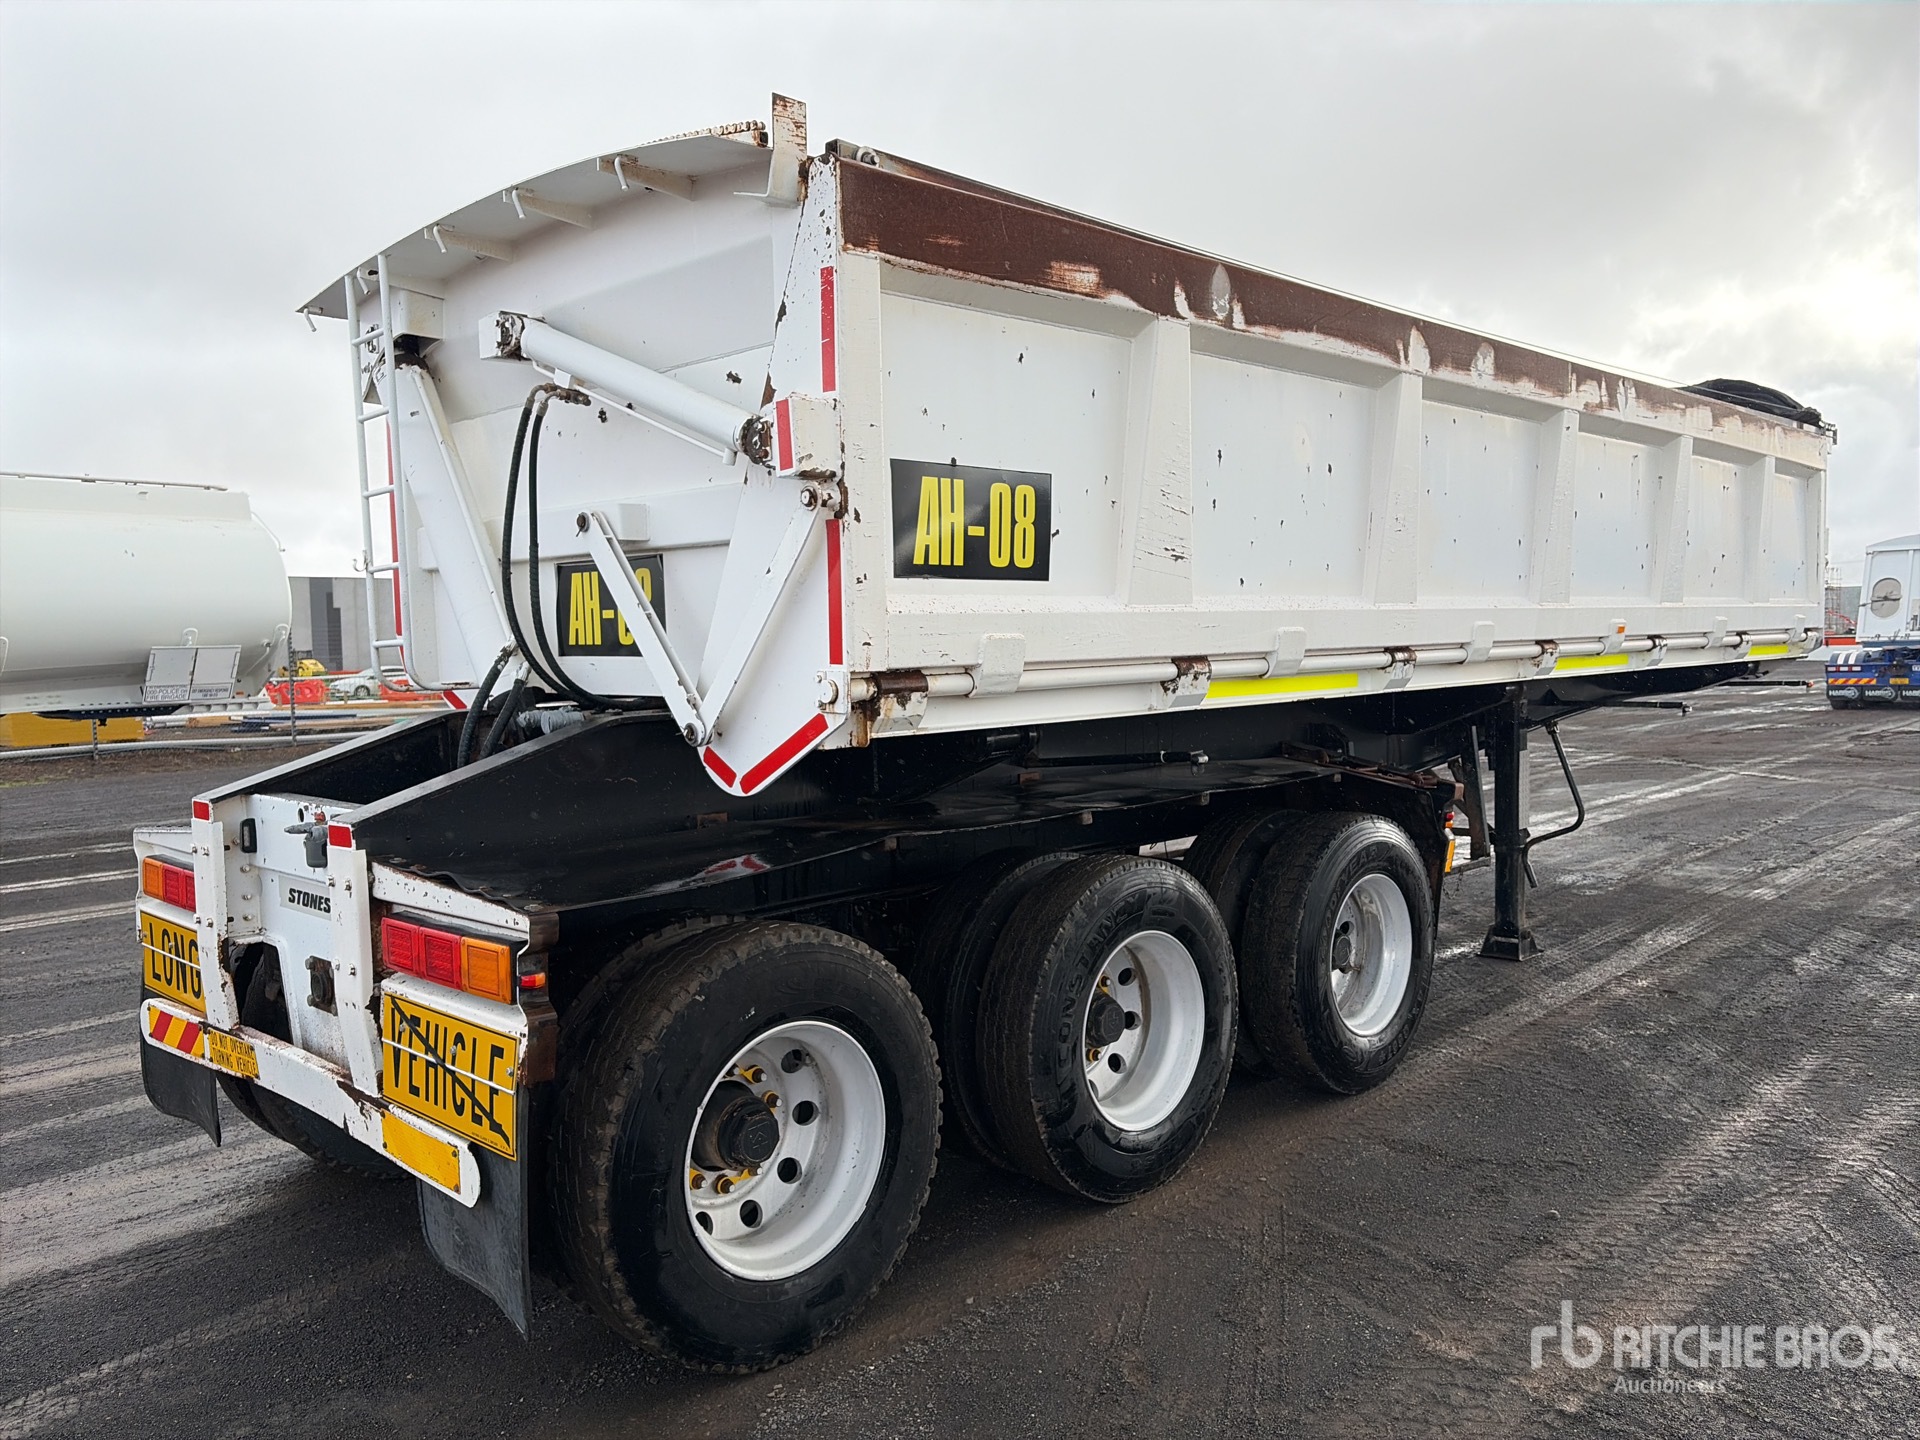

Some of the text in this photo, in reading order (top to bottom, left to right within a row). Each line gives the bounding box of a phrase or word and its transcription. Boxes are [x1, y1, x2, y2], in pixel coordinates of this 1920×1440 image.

[913, 476, 1036, 569] AH-08
[288, 887, 332, 914] STONES
[148, 922, 202, 1000] LONG
[219, 1033, 228, 1051] NOT
[235, 1056, 256, 1077] VEHICLE
[390, 1006, 505, 1133] VEHICLE
